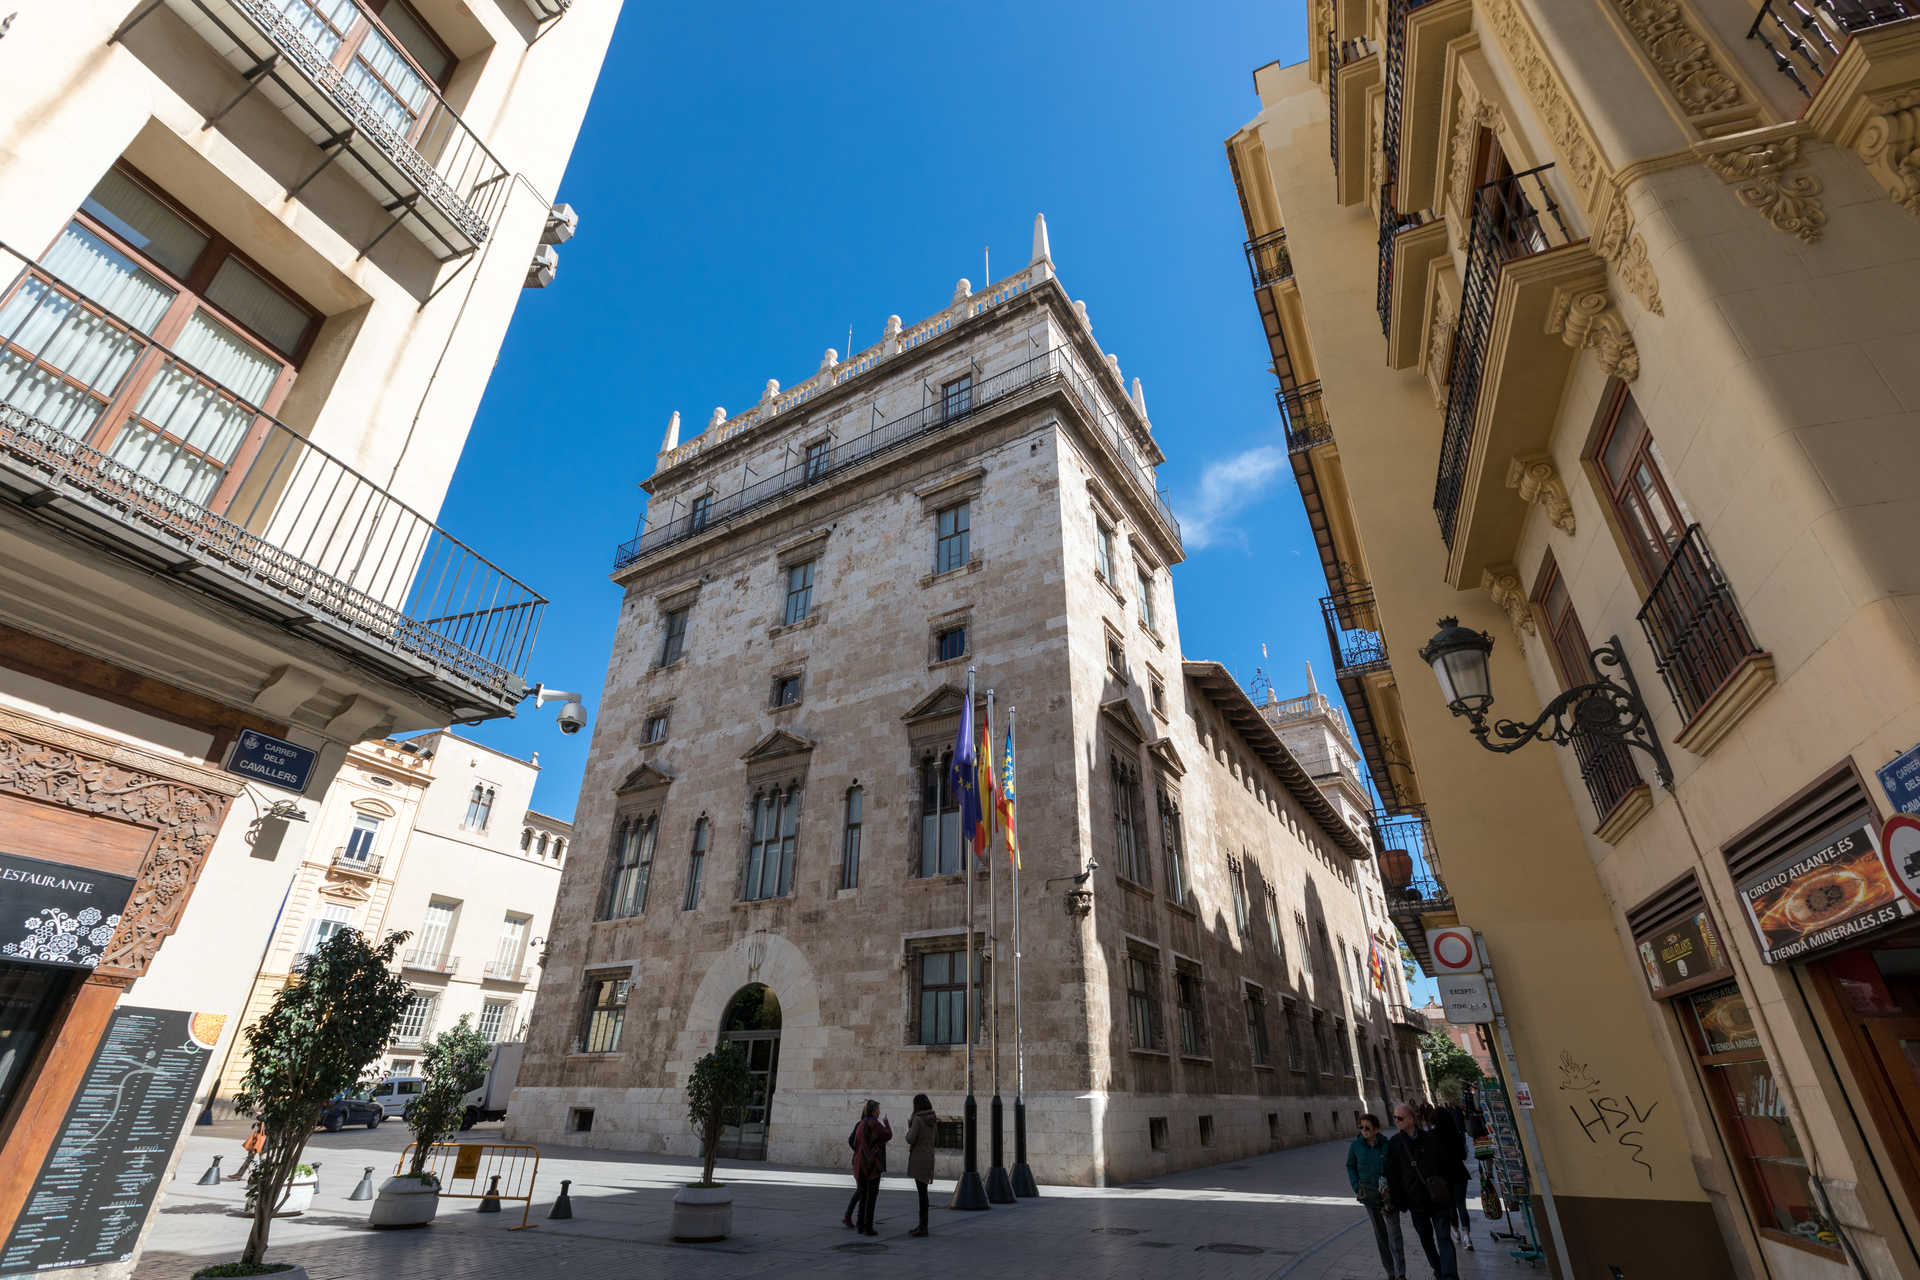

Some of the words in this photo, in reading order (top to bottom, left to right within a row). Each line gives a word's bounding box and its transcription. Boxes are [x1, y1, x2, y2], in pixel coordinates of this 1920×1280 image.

[263, 753, 285, 765] DELS
[264, 743, 297, 758] CARRER
[239, 760, 298, 783] CAVALLERS
[1749, 871, 1788, 899] CIRCULO
[1788, 836, 1854, 881] ATLANTE.ES
[1771, 940, 1809, 961] TIENDA
[1808, 906, 1896, 949] MINERALES.ES
